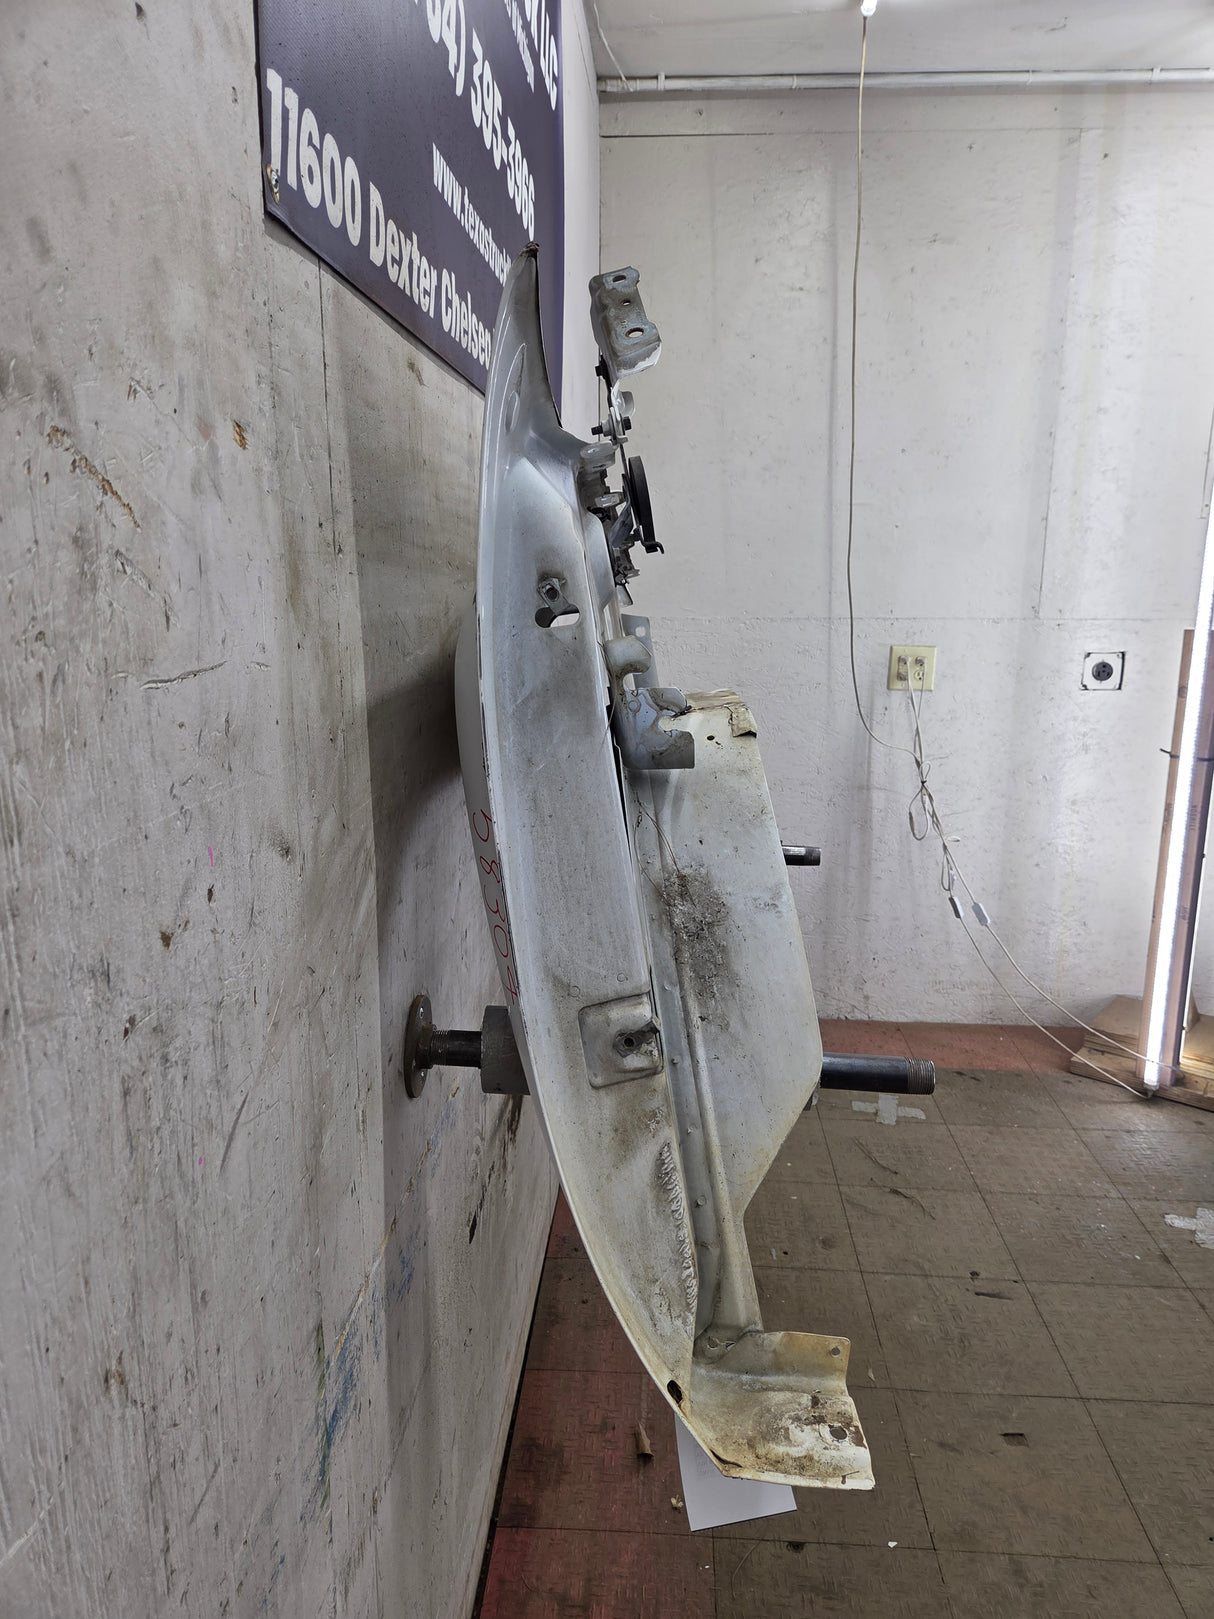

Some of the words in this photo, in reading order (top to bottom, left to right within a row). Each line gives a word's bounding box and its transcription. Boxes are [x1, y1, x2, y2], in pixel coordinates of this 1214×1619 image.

[266, 67, 362, 247] 11600
[369, 181, 438, 318] Dexter
[441, 268, 492, 371] Chelsea
[470, 27, 536, 242] 395-3966
